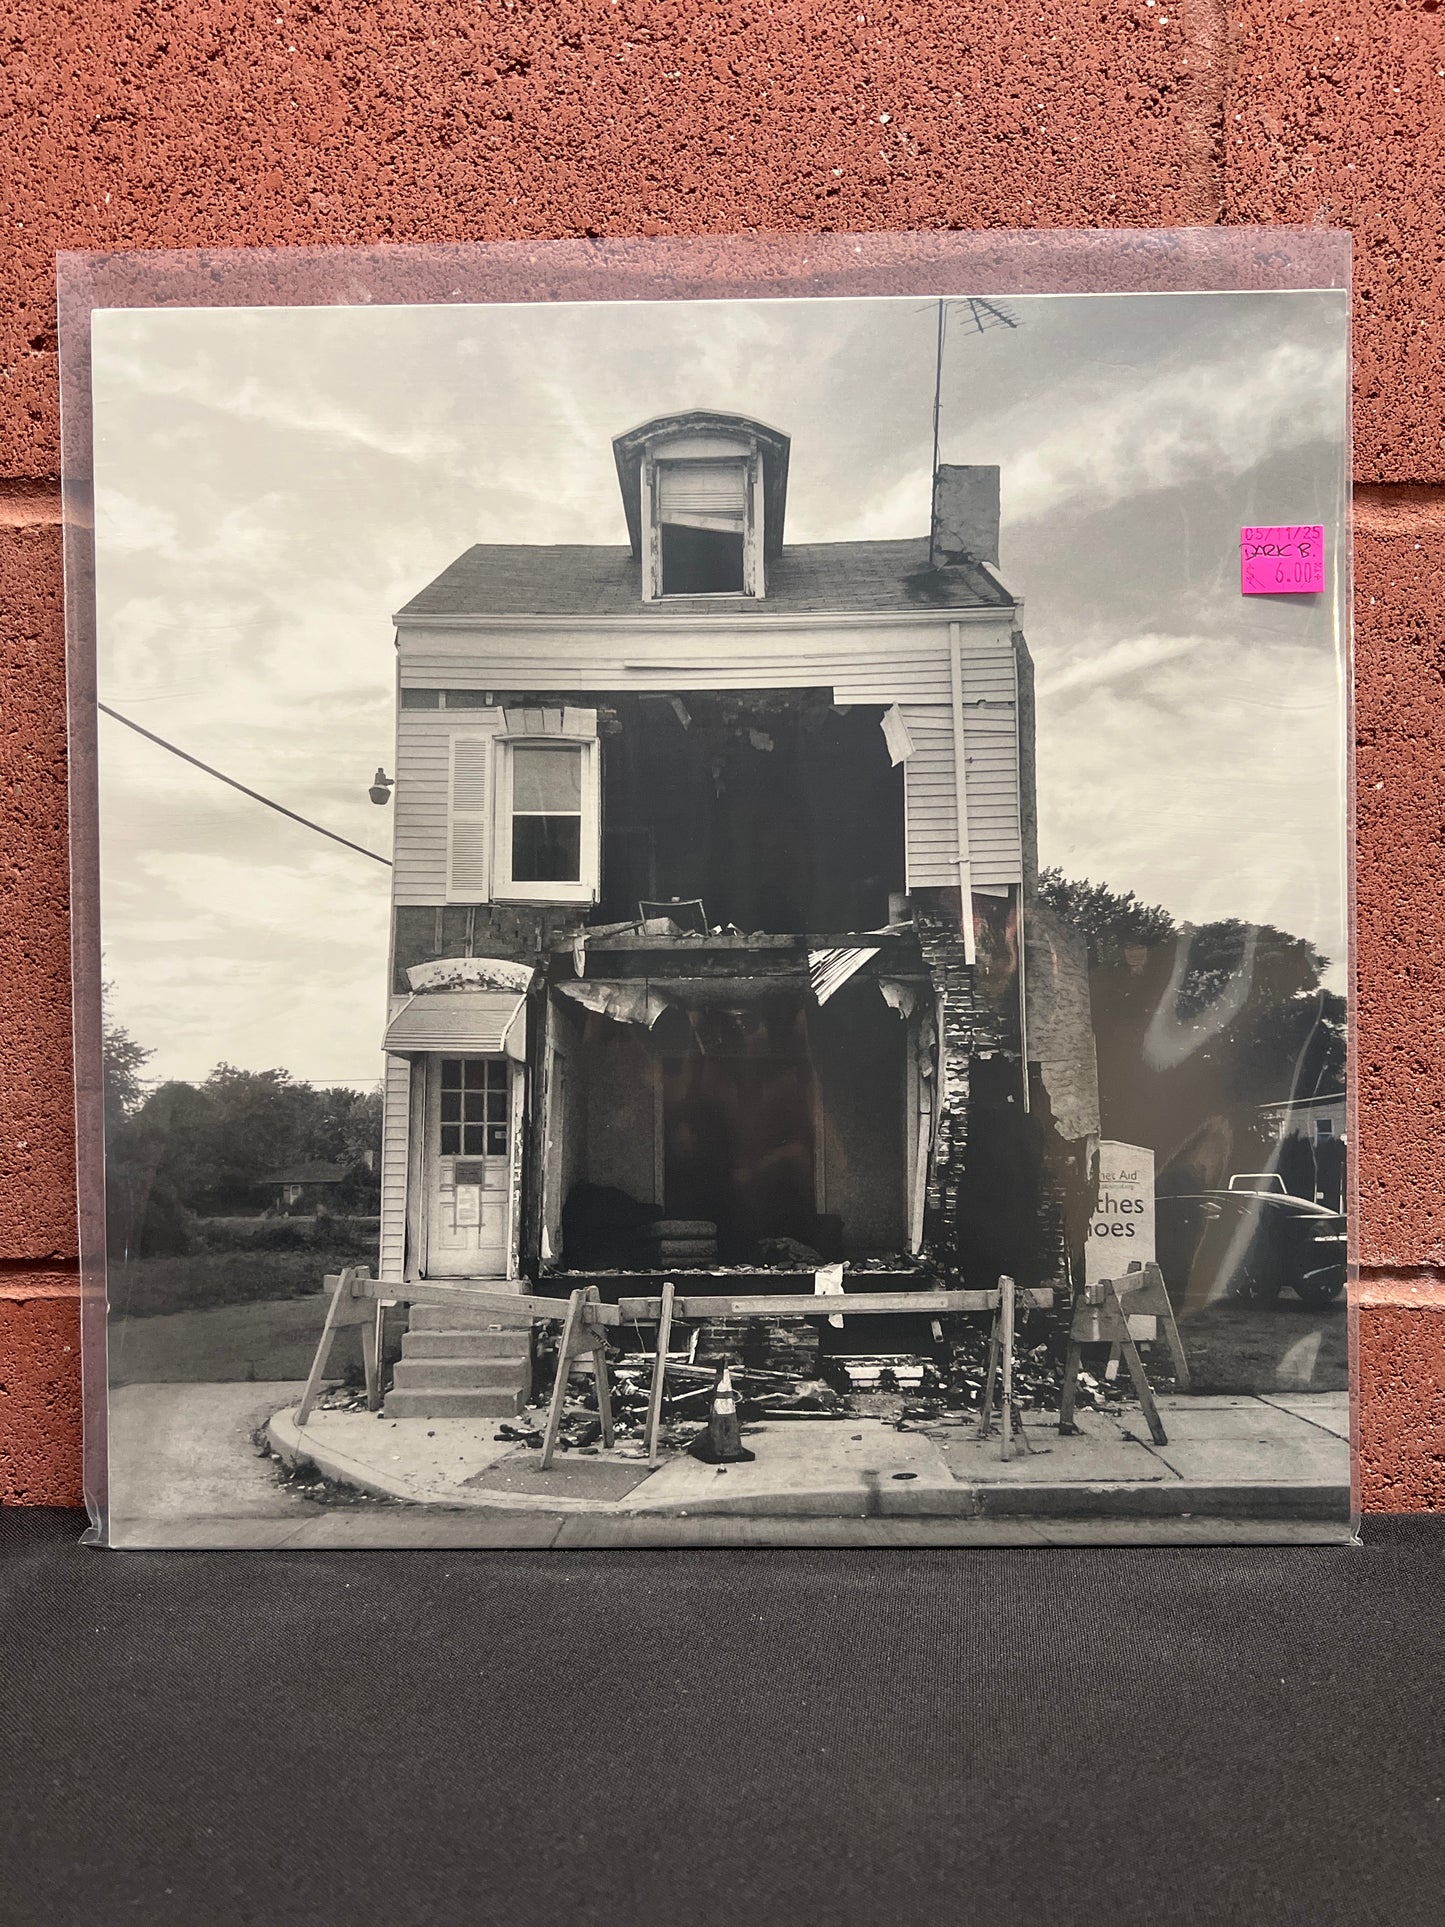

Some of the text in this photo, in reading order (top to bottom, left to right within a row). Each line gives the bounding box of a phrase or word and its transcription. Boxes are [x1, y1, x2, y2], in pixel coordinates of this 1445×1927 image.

[1238, 543, 1292, 560] DARK
[1275, 561, 1311, 583] 6.00
[1119, 1170, 1137, 1180] Aid
